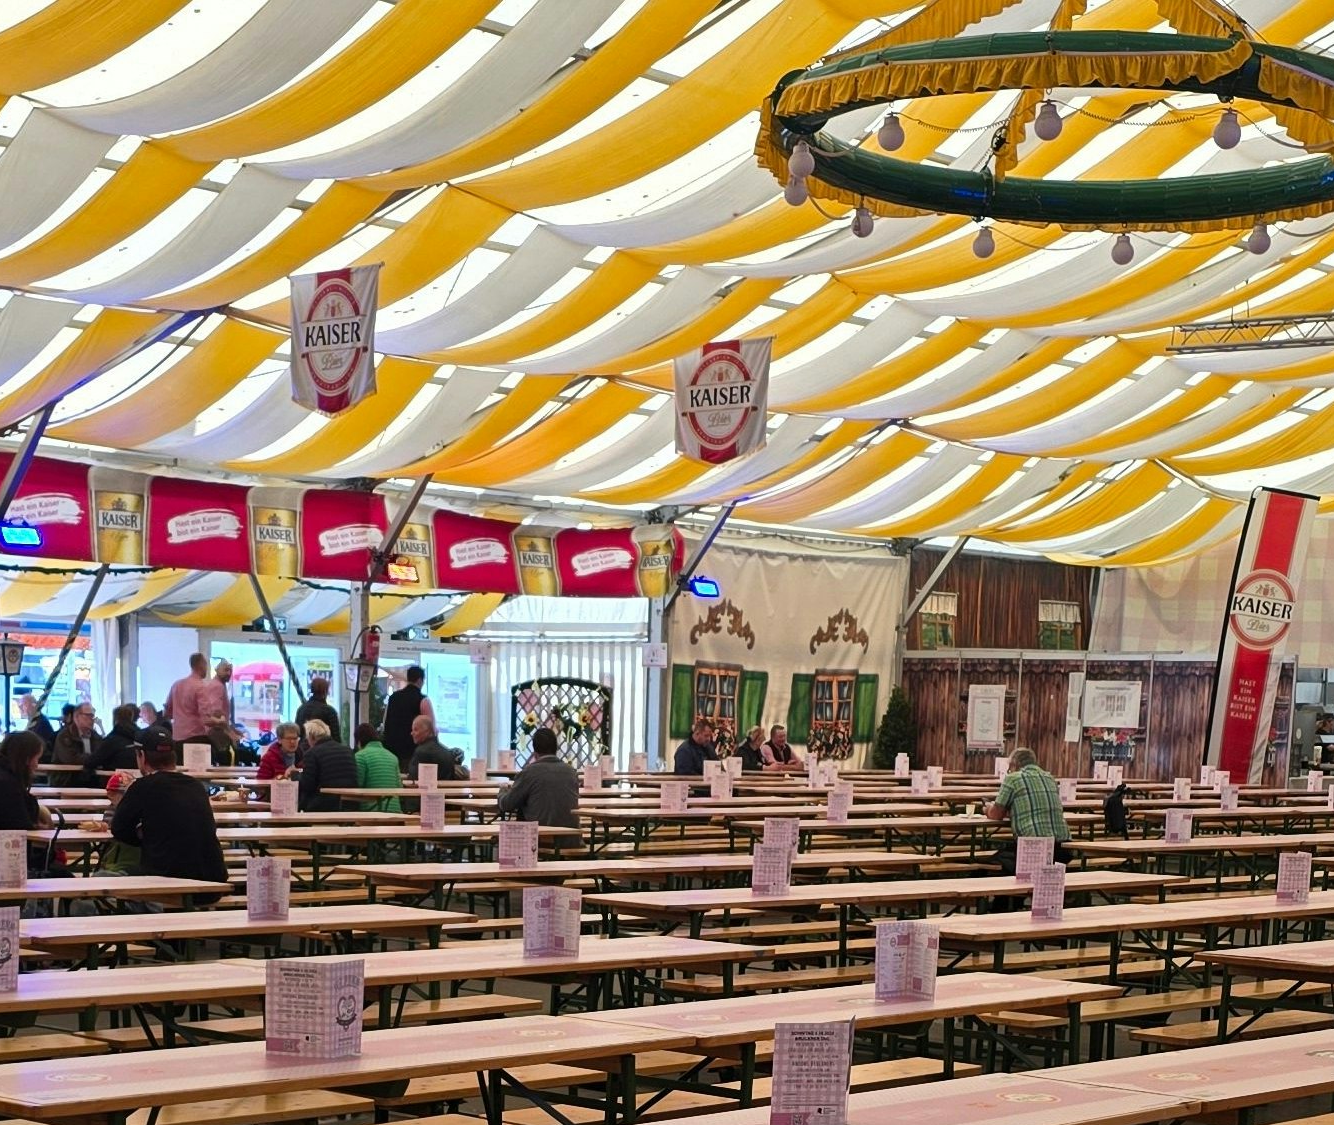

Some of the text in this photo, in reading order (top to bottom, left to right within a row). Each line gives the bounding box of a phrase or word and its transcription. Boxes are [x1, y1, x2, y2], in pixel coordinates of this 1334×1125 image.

[305, 321, 361, 347] KAISER
[690, 384, 751, 408] KAISER
[101, 512, 141, 528] KAISER
[258, 526, 293, 541] KAISER
[1232, 596, 1293, 620] KAISER
